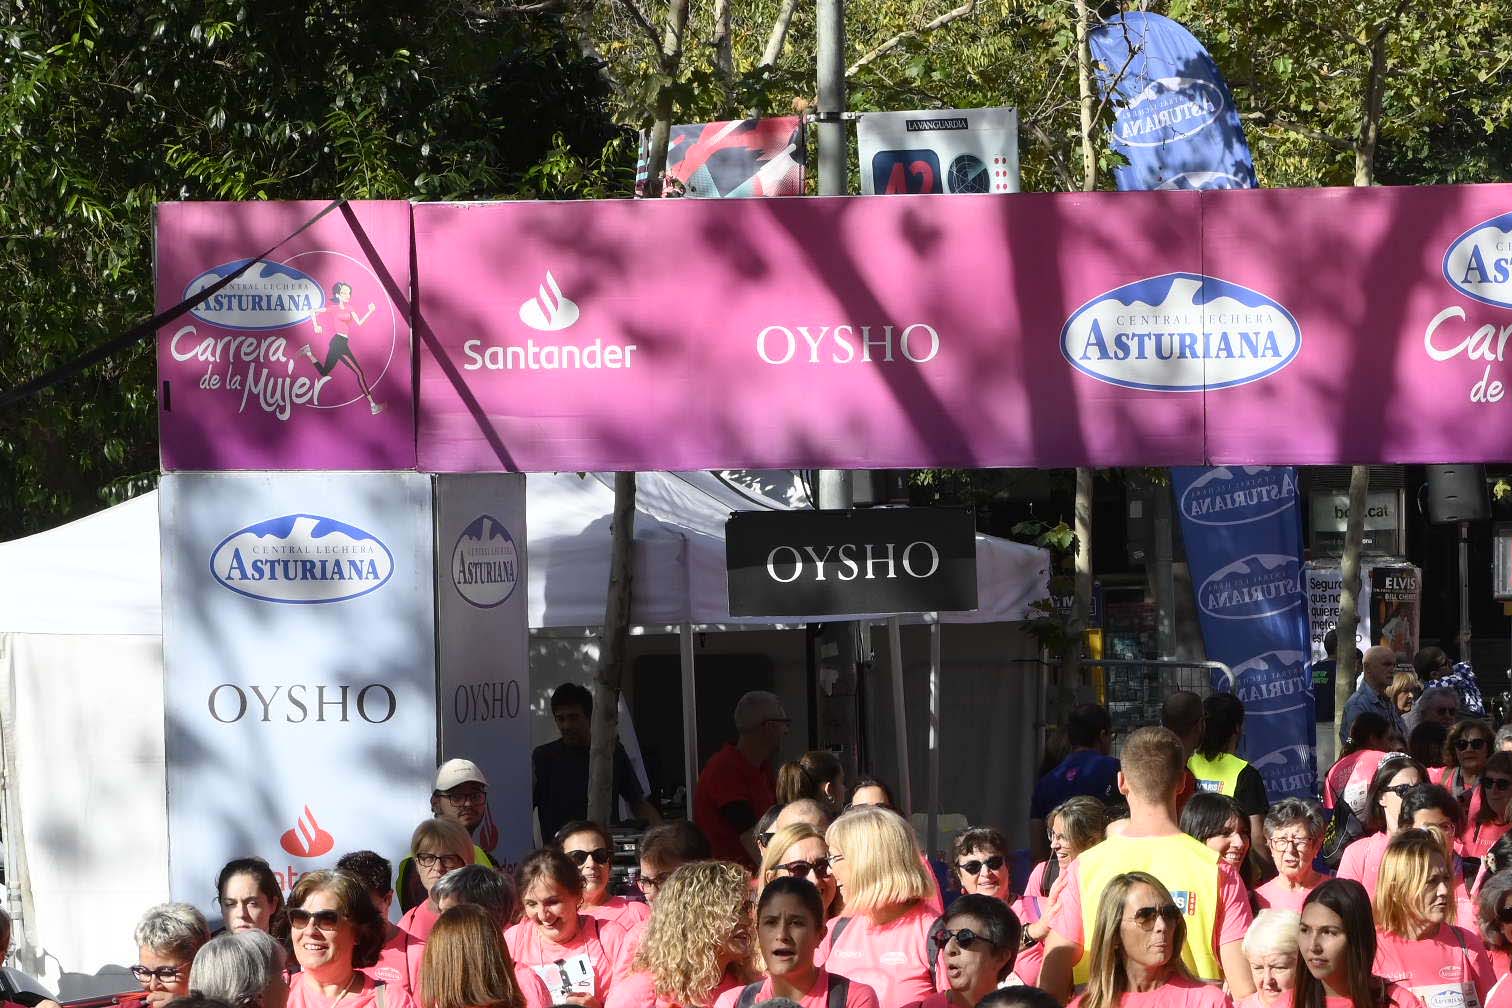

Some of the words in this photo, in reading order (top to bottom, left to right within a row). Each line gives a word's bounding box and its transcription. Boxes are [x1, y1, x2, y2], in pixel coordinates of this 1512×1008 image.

[195, 285, 313, 312] ASTURIANA
[1116, 313, 1192, 327] CENTRAL
[170, 325, 288, 362] Carrera
[463, 338, 637, 372] Santander
[756, 323, 940, 366] OYSHO
[1079, 317, 1283, 361] ASTURIANA
[200, 364, 220, 390] de
[227, 364, 241, 390] la
[238, 358, 332, 421] Mujer
[1470, 364, 1504, 403] de
[225, 547, 380, 582] ASTURIANA
[252, 545, 311, 555] CENTRAL
[316, 545, 375, 555] LECHERA
[457, 550, 515, 585] ASTURIANA
[766, 541, 940, 584] OYSHO
[1385, 577, 1416, 589] ELVIS
[207, 683, 398, 724] OYSHO
[454, 679, 520, 725] OYSHO
